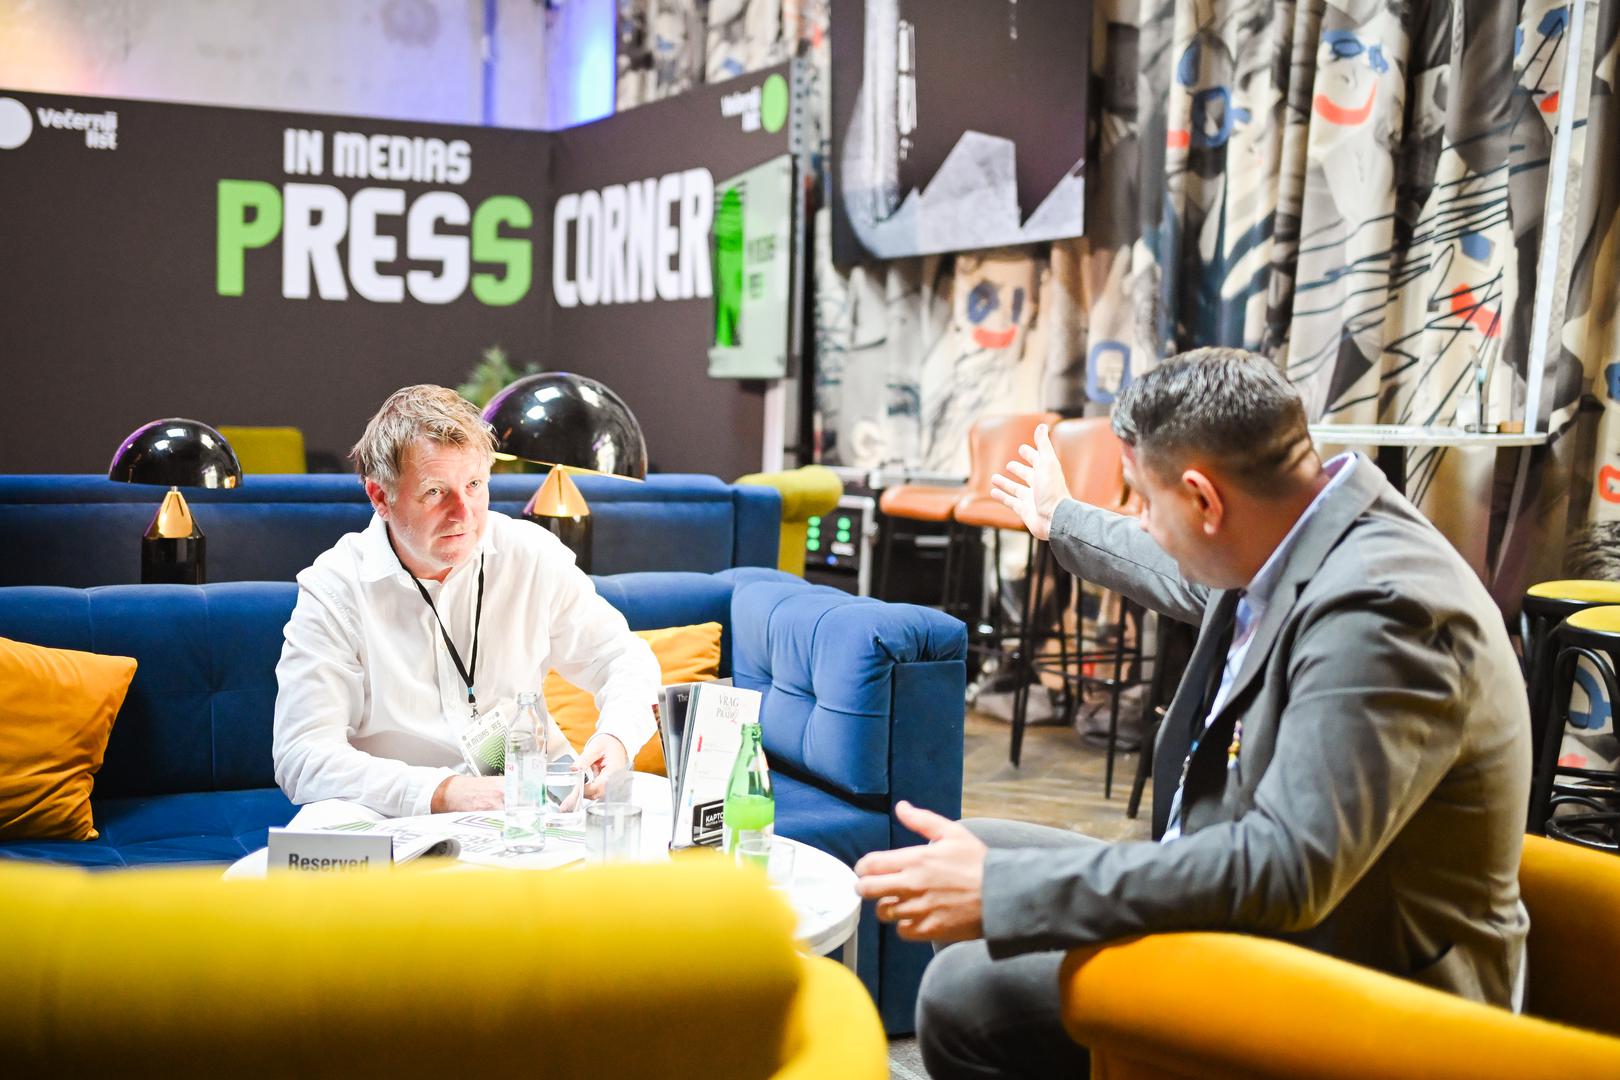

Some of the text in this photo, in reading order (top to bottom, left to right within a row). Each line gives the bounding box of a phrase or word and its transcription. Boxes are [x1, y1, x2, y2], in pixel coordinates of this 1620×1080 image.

[283, 128, 472, 184] IN MEDIAS
[217, 167, 715, 308] PRESS CORNER
[288, 853, 369, 873] Reserved
